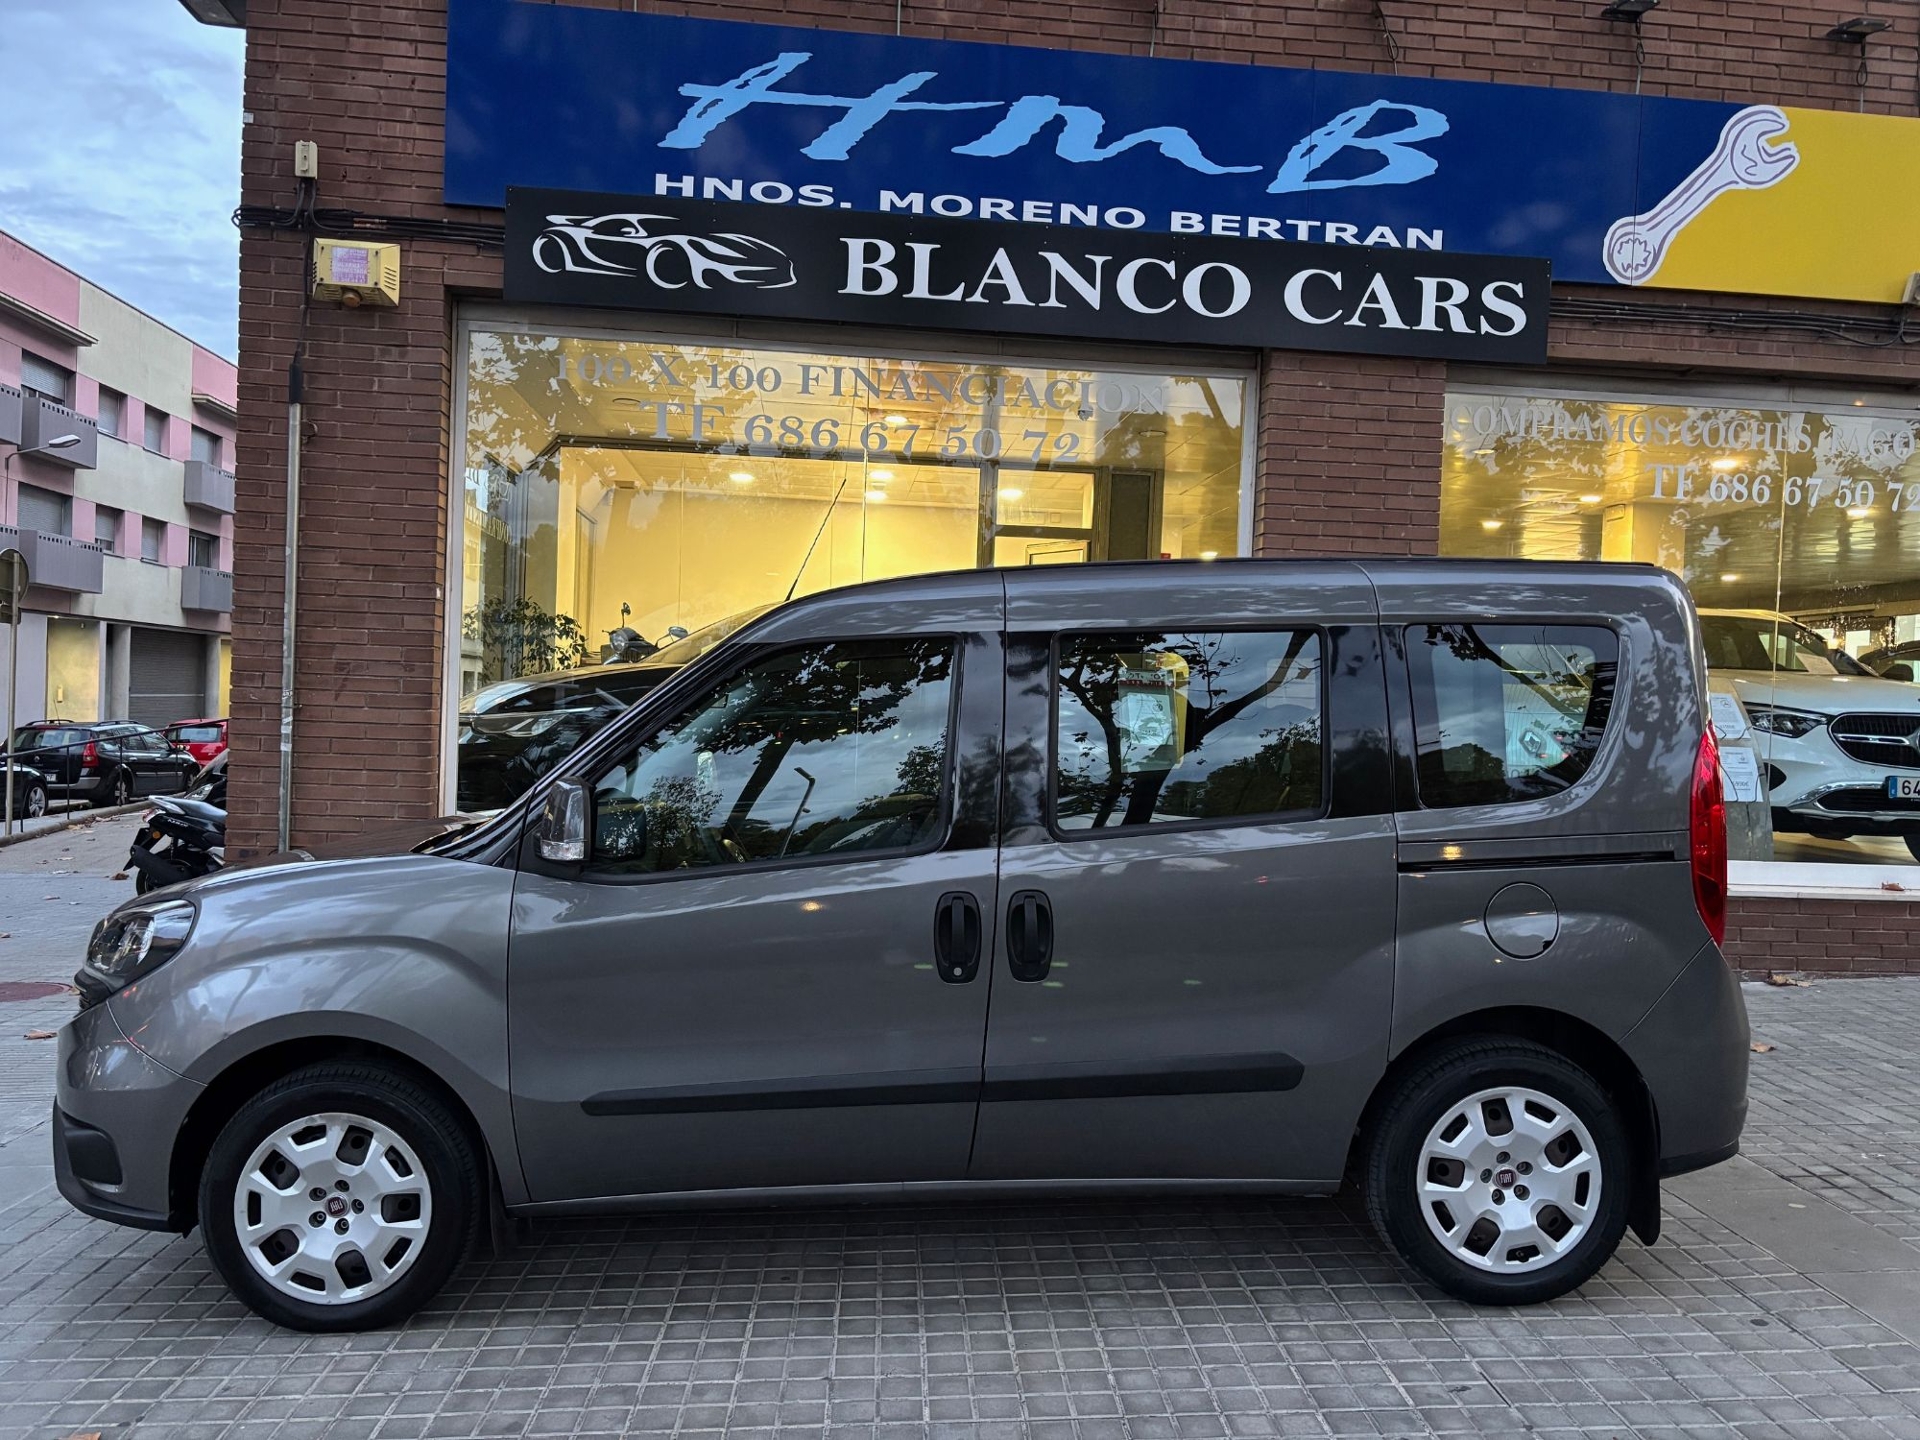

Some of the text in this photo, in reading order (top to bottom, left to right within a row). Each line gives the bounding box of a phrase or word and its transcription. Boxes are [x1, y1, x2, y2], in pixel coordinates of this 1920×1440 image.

[656, 173, 1443, 251] HNOS. MORENO BERTRAN
[837, 237, 1527, 336] BLANCO CARS
[554, 353, 632, 384] 100
[649, 353, 685, 387] X
[706, 363, 782, 392] 100
[638, 400, 1080, 463] TF 686 67 50 72
[1450, 404, 1671, 446] COMPRAMOS
[1680, 416, 1812, 453] COCHES
[1645, 463, 1920, 512] TF 686 67 50 72
[1499, 1172, 1512, 1184] FIAT
